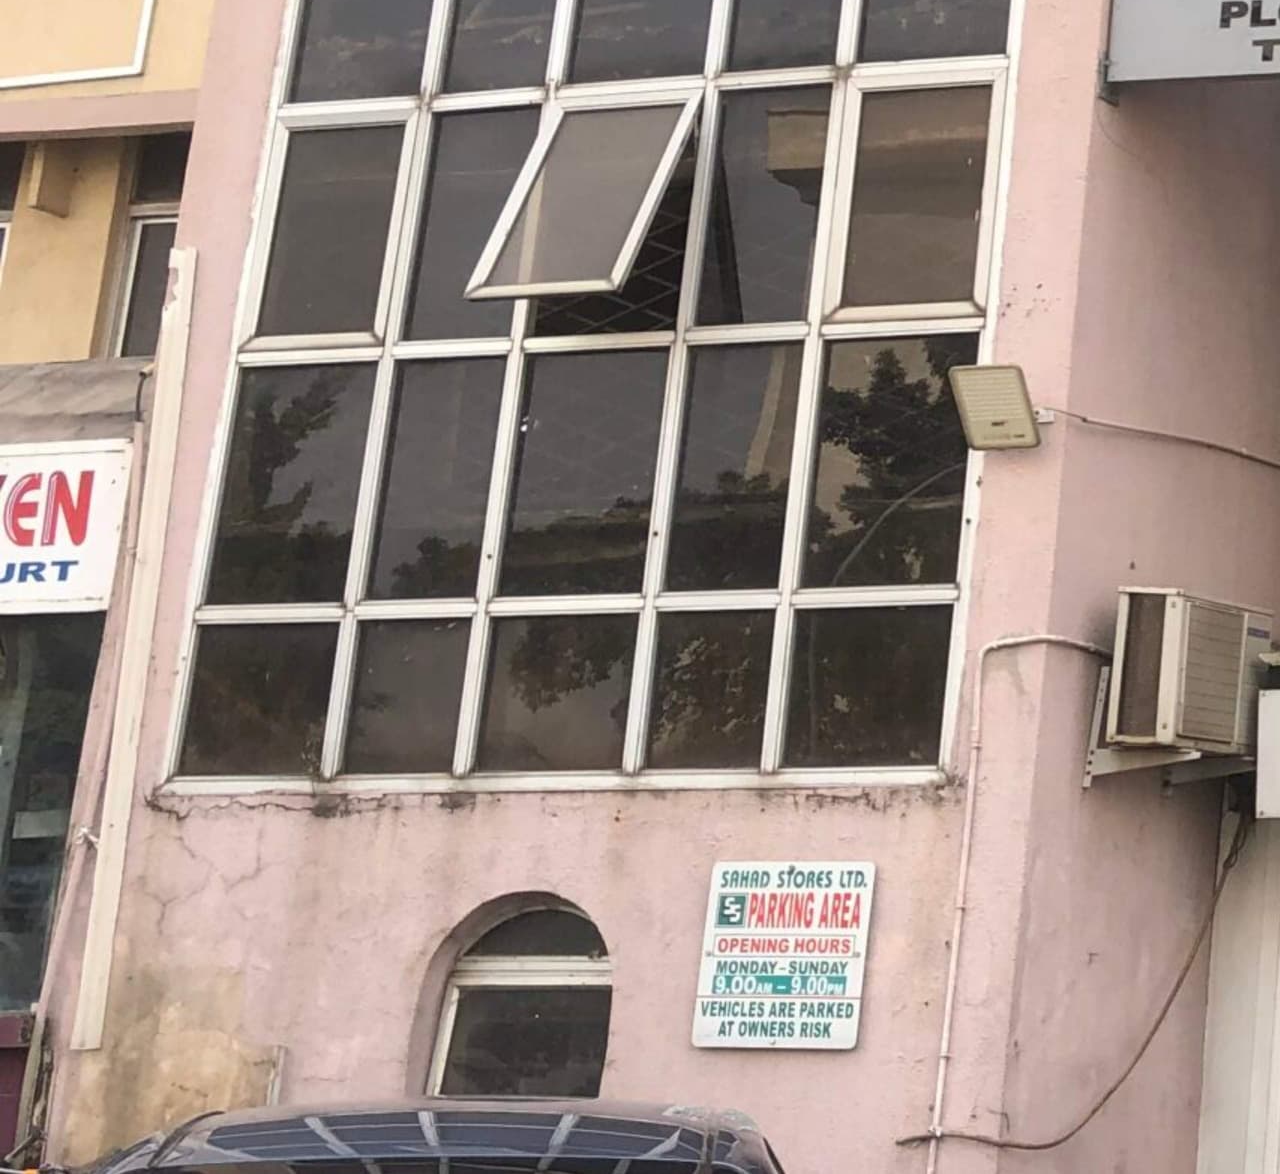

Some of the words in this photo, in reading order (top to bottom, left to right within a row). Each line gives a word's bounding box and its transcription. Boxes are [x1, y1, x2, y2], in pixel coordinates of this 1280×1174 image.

[0, 470, 95, 547] EN
[720, 870, 770, 888] SAHAD
[777, 869, 833, 888] STORES
[839, 870, 868, 888] LTD.
[748, 892, 815, 928] PARKING
[818, 892, 861, 928] AREA
[717, 938, 790, 953] OPENING
[793, 938, 851, 954] HOURS
[715, 960, 777, 975] MONDAY
[788, 960, 848, 975] SUNDAY
[701, 1001, 765, 1017] VEHICLES
[769, 1001, 795, 1018] ARE
[800, 1002, 854, 1018] PARKED
[717, 1021, 734, 1036] AT
[738, 1021, 795, 1038] OWNERS
[800, 1022, 832, 1038] RISK
